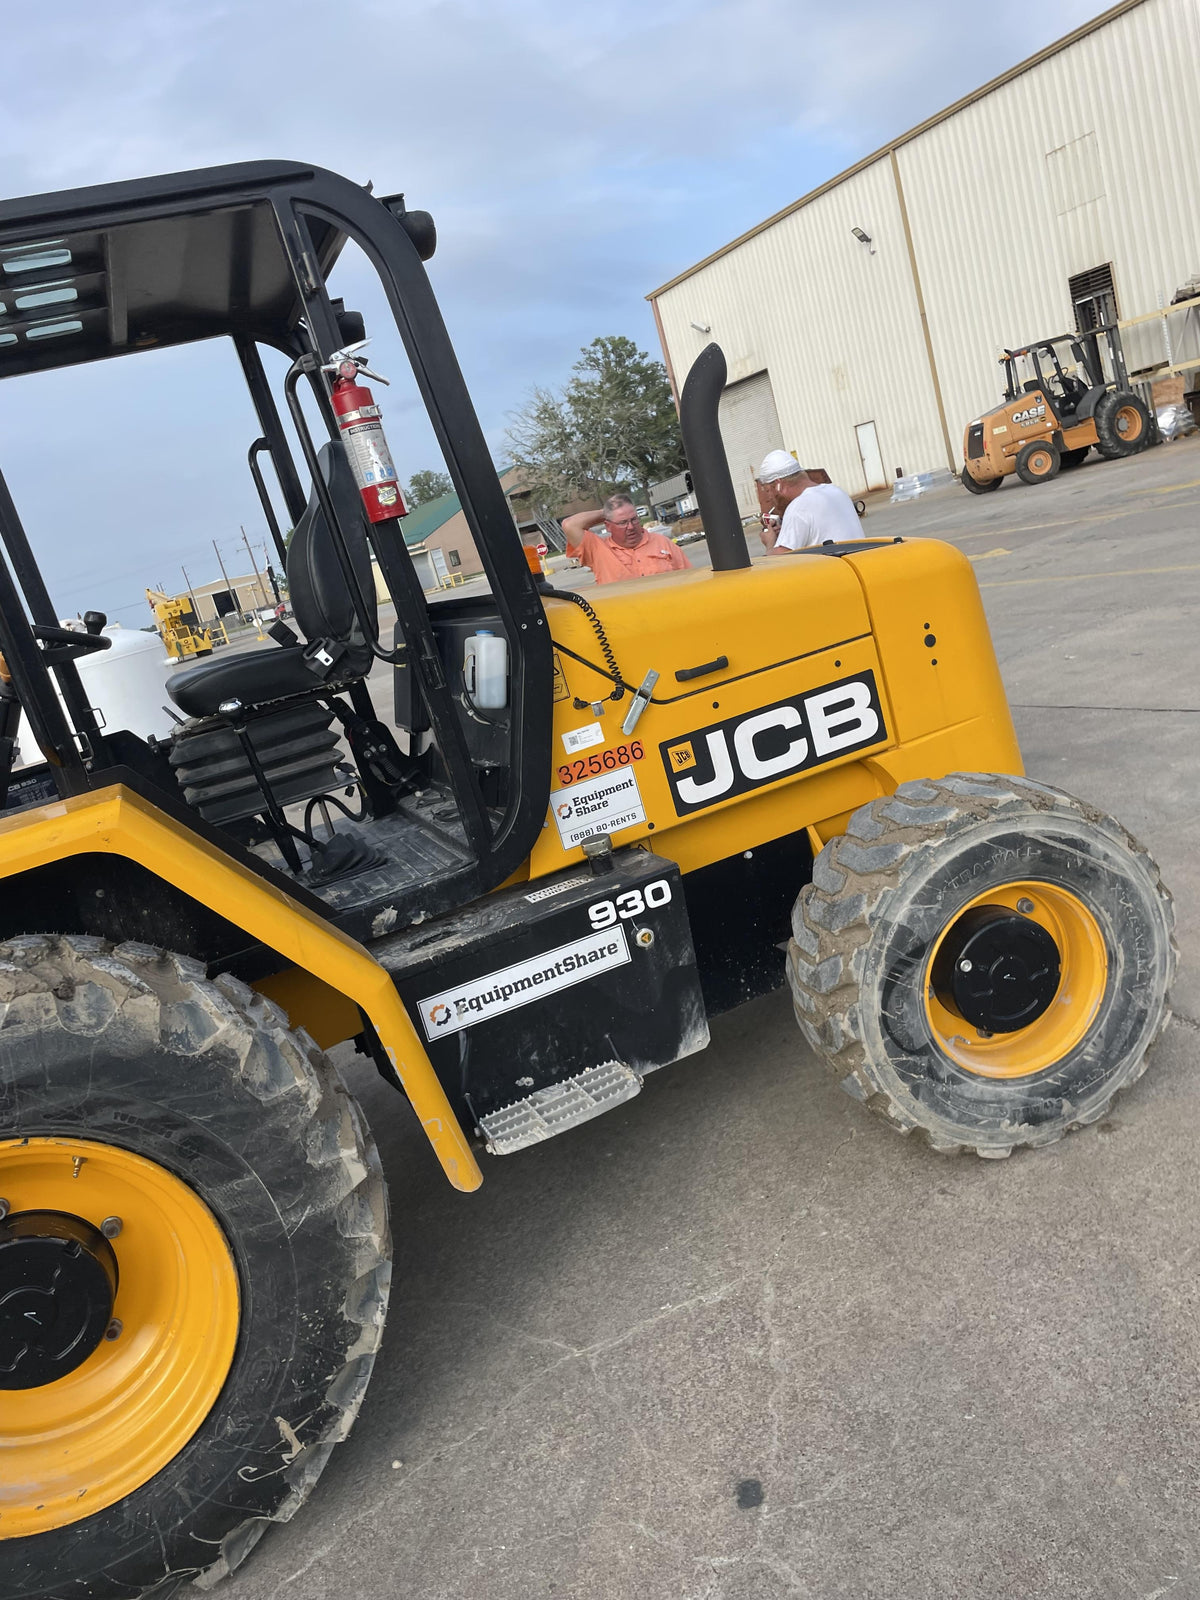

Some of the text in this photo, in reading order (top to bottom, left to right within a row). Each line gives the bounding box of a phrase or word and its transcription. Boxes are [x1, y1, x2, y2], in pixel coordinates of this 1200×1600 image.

[1012, 405, 1045, 423] CASE
[675, 681, 880, 804] JCB
[558, 741, 645, 786] 325686
[675, 751, 691, 764] JCB
[572, 779, 634, 807] Equipment
[575, 800, 609, 817] Share
[571, 813, 637, 842] (888) 80-RENTS
[588, 879, 672, 930] 930
[453, 942, 619, 1015] EquipmentShare
